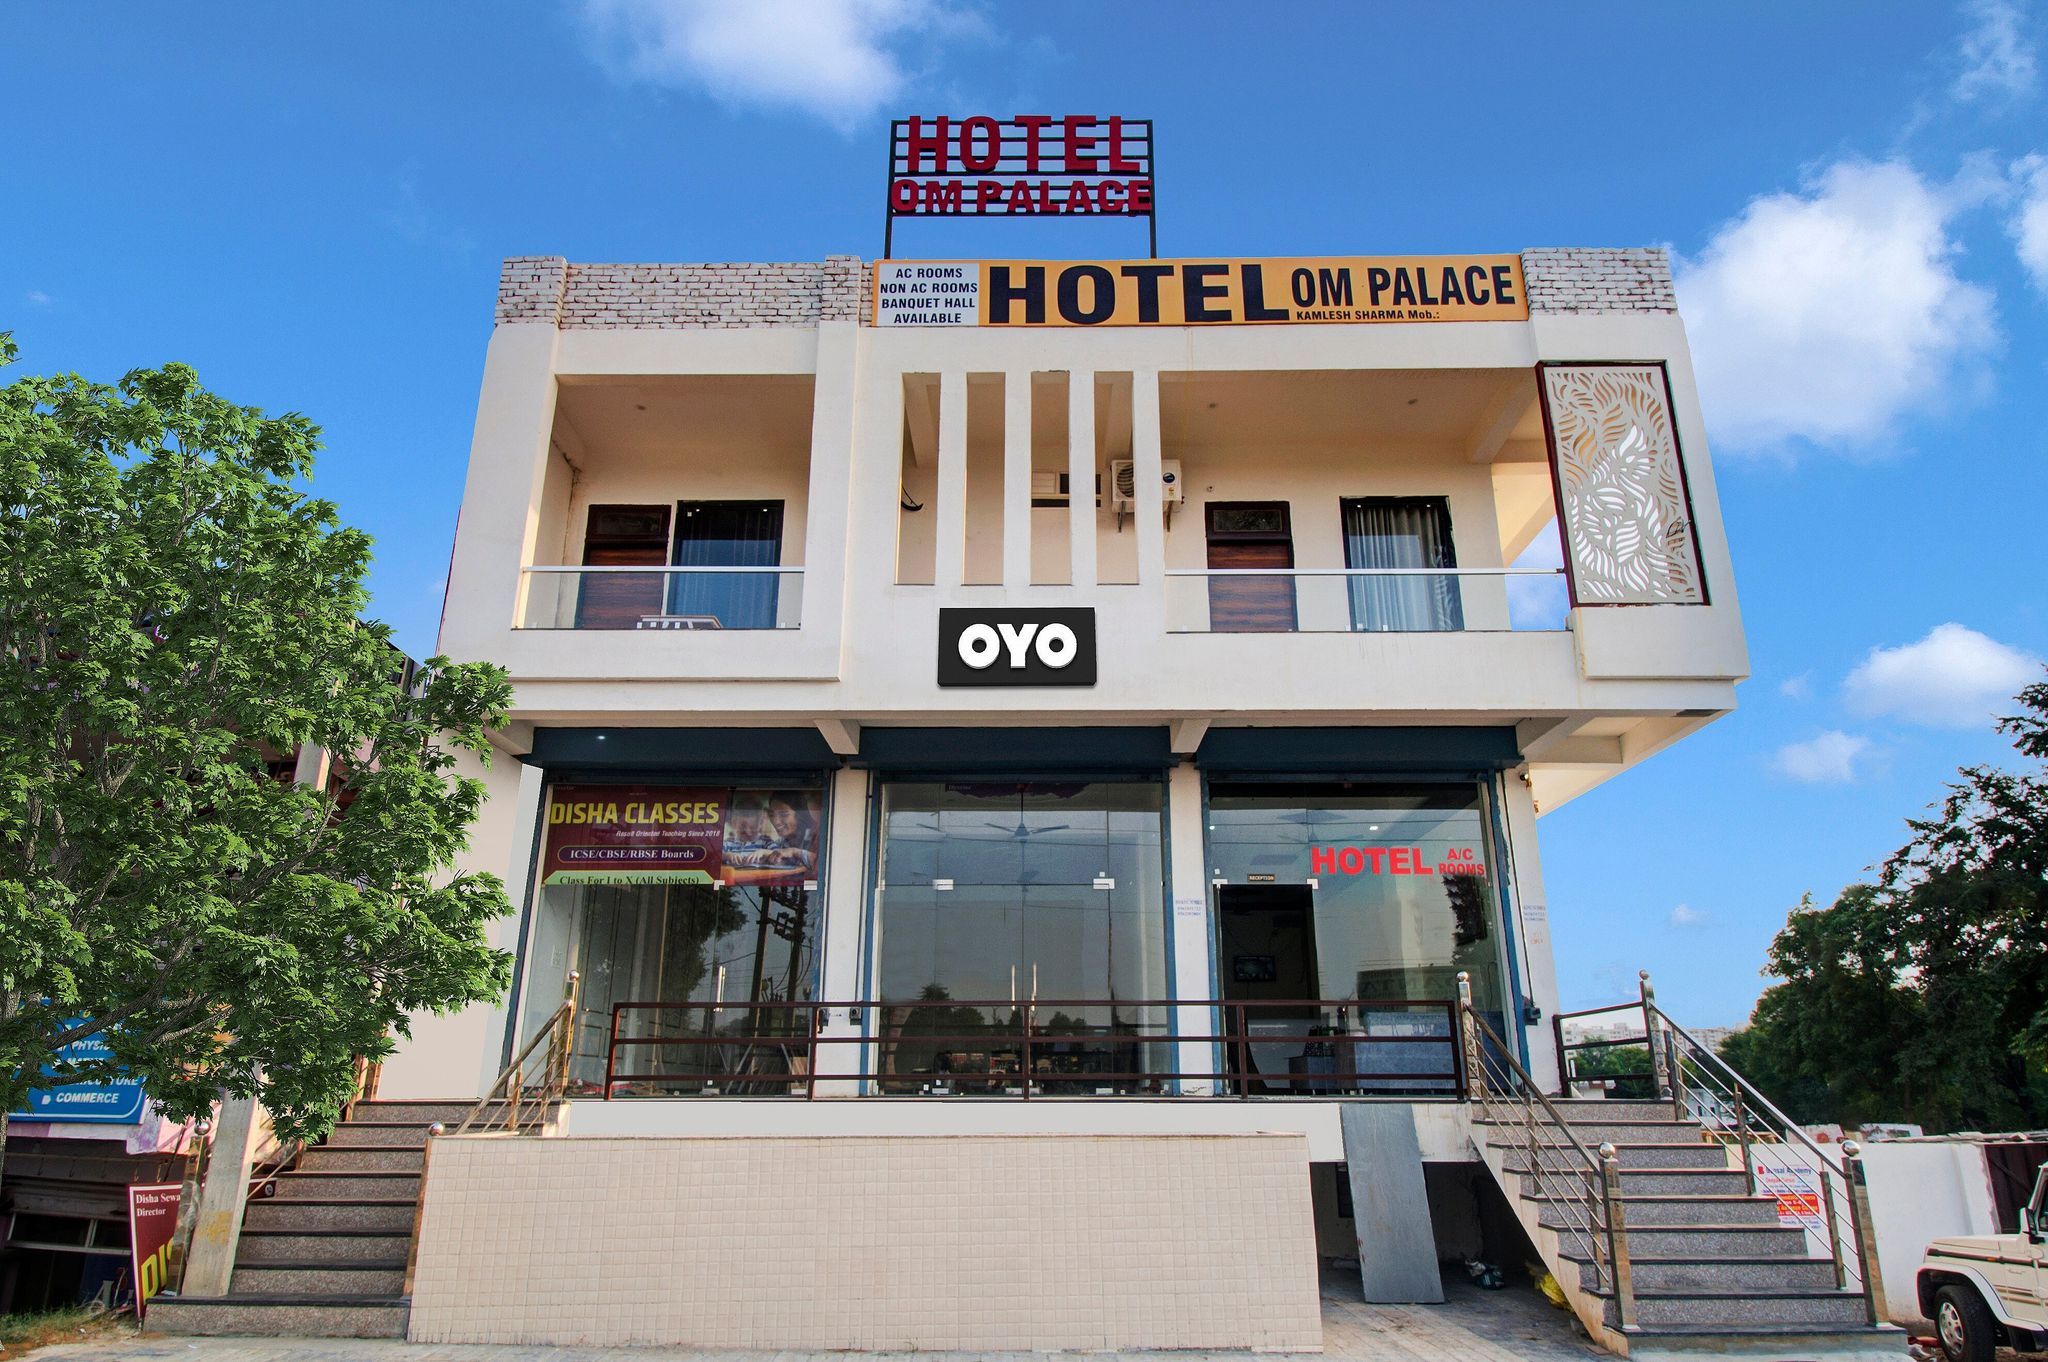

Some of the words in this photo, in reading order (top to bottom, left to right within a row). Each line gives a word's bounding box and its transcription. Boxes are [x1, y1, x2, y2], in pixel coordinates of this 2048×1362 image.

[907, 115, 1141, 173] HOTEL
[891, 179, 962, 213] OM
[976, 179, 1152, 214] PALACE
[896, 268, 912, 278] AC
[917, 268, 963, 278] ROOMS
[880, 283, 906, 293] NON
[910, 283, 927, 293] AC
[932, 282, 978, 293] ROOMS
[988, 264, 1290, 325] HOTEL
[1291, 267, 1354, 307] OM
[1367, 265, 1516, 306] PALACE
[881, 298, 940, 309] BANQUET
[944, 297, 975, 308] HALL
[893, 313, 962, 323] AVAILABLE
[1296, 310, 1351, 320] KAMLESH
[1355, 310, 1404, 320] SHARMA
[1408, 309, 1440, 319] Mob.:
[958, 623, 1078, 669] OYO
[550, 802, 618, 824] DISHA
[624, 803, 720, 824] CLASSES
[662, 830, 686, 838] Teaching
[570, 849, 658, 859] ICSE/CBSE/RBSE
[661, 849, 694, 859] Boards
[1447, 847, 1473, 861] A/C
[1311, 846, 1434, 875] HOTEL
[1438, 863, 1485, 876] ROOMS
[559, 875, 584, 884] Class
[587, 875, 604, 884] For
[625, 876, 633, 884] X
[56, 1092, 120, 1103] COMMERCE
[136, 1193, 159, 1204] Disha
[137, 1208, 166, 1217] Director
